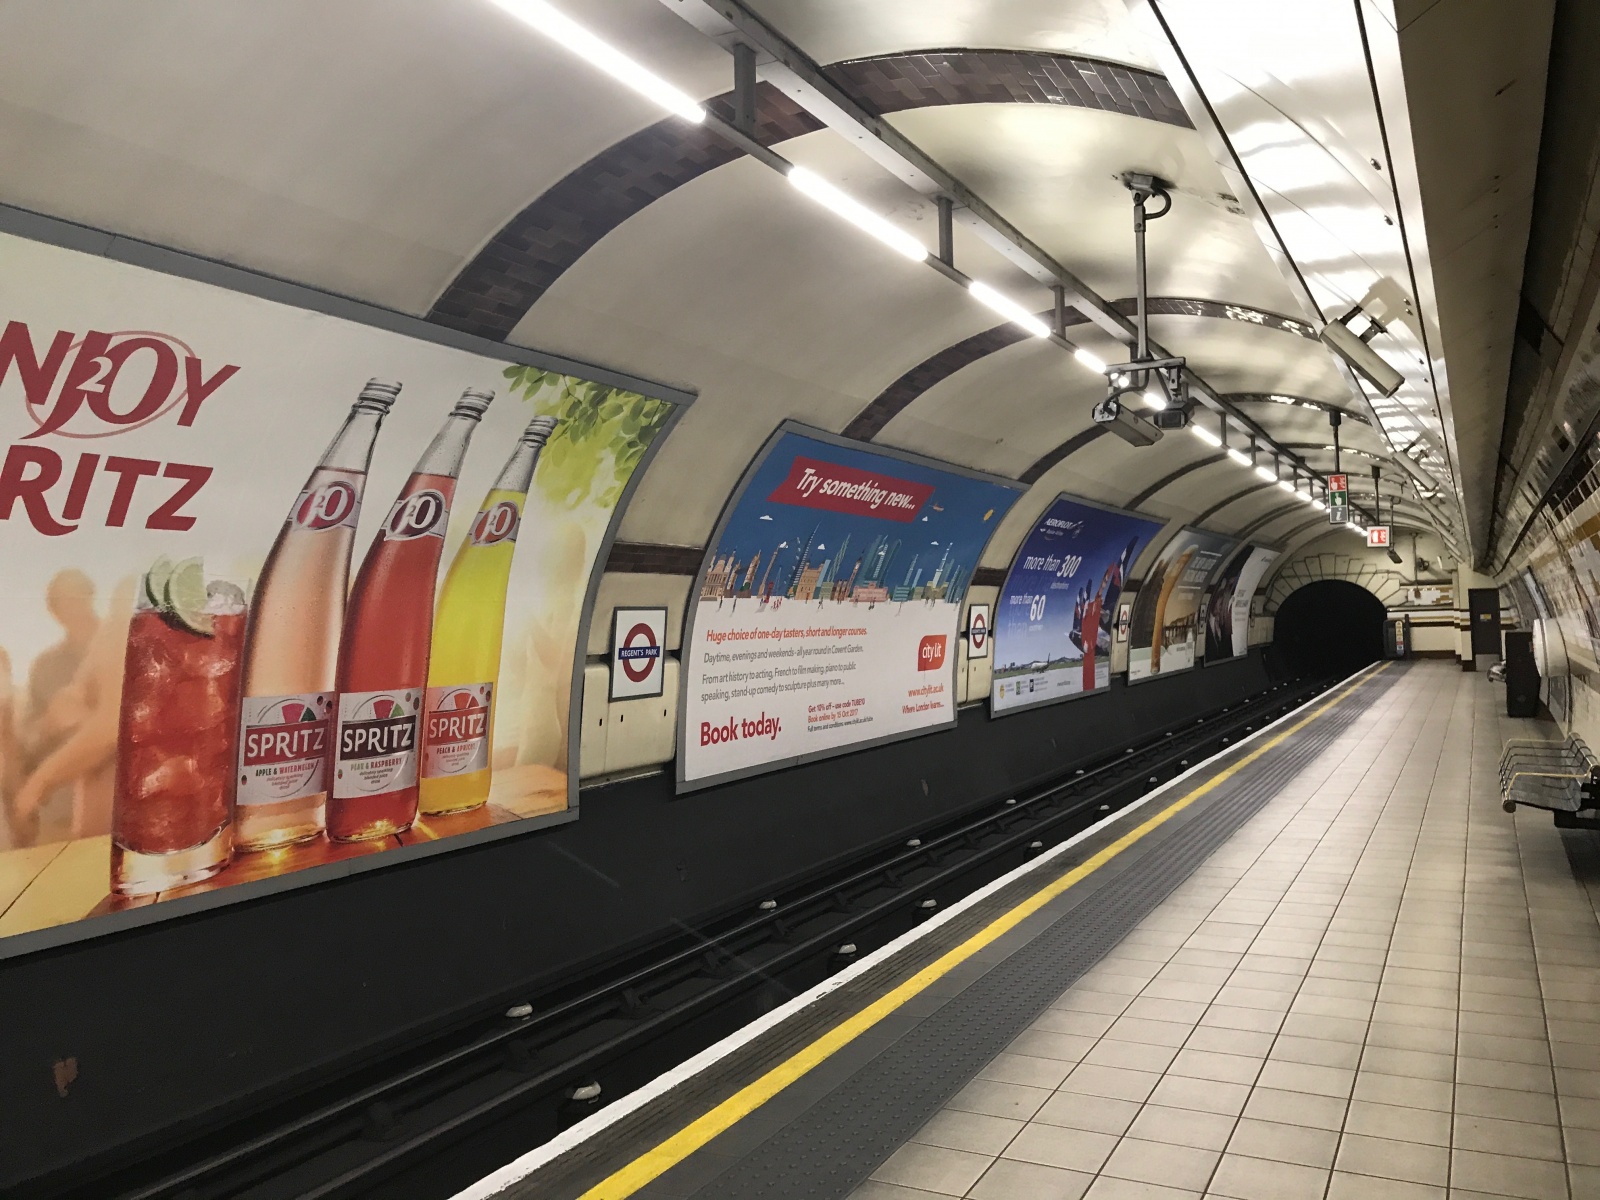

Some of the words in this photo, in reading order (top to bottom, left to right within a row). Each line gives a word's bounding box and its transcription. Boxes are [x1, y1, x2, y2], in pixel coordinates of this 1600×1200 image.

[0, 445, 213, 536] RITZ
[797, 468, 823, 498] Try
[819, 479, 886, 509] something
[884, 491, 915, 510] new...
[1023, 556, 1044, 570] more
[1043, 554, 1060, 571] than
[1057, 555, 1082, 578] 300
[1010, 595, 1022, 604] more
[1030, 594, 1046, 621] 60
[707, 629, 726, 645] Huge
[728, 628, 749, 640] choice
[750, 627, 758, 639] of
[758, 627, 782, 641] one-day
[806, 626, 820, 637] short
[821, 626, 832, 637] and
[832, 626, 848, 639] longer
[621, 649, 644, 657] REGENT'S
[645, 648, 657, 656] PARK
[704, 652, 731, 665] Daytime,
[732, 650, 756, 662] evenings
[757, 648, 767, 659] and
[768, 647, 794, 658] weekends
[802, 649, 812, 659] year
[813, 646, 827, 655] round
[832, 645, 847, 654] Covent
[922, 643, 934, 662] city
[702, 674, 718, 684] From
[720, 674, 728, 683] art
[729, 671, 748, 683] history
[749, 671, 755, 680] to
[775, 666, 791, 677] French
[798, 665, 806, 674] film
[825, 663, 838, 674] piano
[701, 689, 730, 704] speaking,
[731, 686, 756, 698] stand-up
[757, 683, 778, 695] comedy
[779, 684, 784, 692] to
[785, 681, 806, 692] sculpture
[806, 680, 817, 691] plus
[817, 680, 829, 689] many
[916, 702, 930, 712] London
[429, 713, 485, 738] SPRITZ
[701, 716, 738, 746] Book
[741, 711, 781, 740] today.
[247, 728, 325, 758] SPRITZ
[343, 723, 413, 753] SPRITZ
[256, 768, 271, 776] APPLE
[371, 758, 401, 768] RASPBERRY
